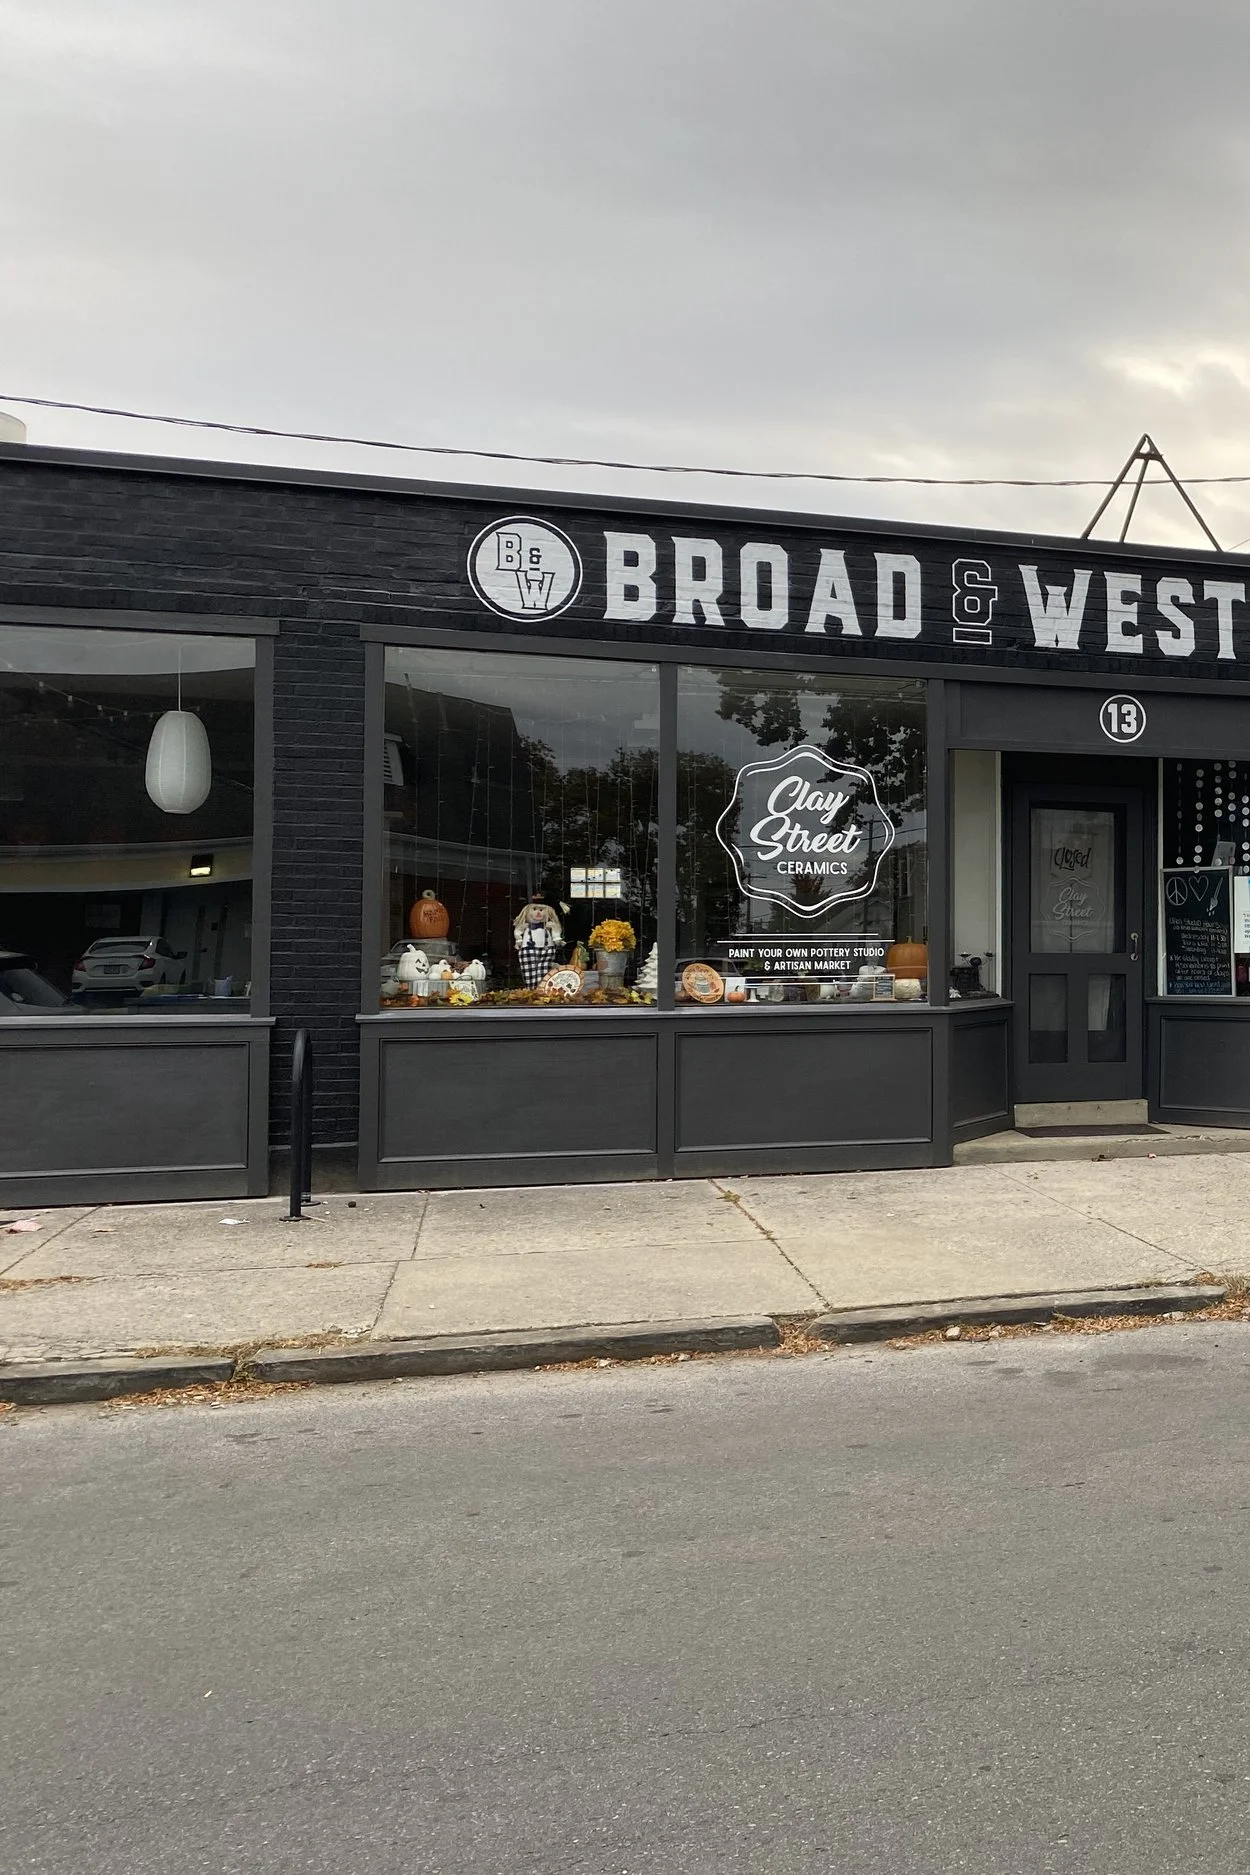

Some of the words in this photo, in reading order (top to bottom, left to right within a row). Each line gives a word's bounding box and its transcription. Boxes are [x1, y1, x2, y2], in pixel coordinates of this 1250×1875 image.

[602, 531, 922, 639] BROAD
[951, 558, 999, 645] &
[1107, 703, 1137, 734] 13
[767, 775, 849, 824] Clay
[749, 813, 863, 861] Street
[776, 861, 848, 875] CERAMICS
[1059, 887, 1088, 906] Clay
[1052, 902, 1094, 920] Street
[728, 948, 754, 958] PAINT
[758, 948, 782, 958] YOUR
[785, 948, 808, 958] OWN
[810, 948, 850, 957] POTTERY
[853, 947, 884, 957] STUDIO
[764, 961, 771, 971] &
[774, 961, 812, 971] ARTISAN
[814, 960, 851, 970] MARKET
